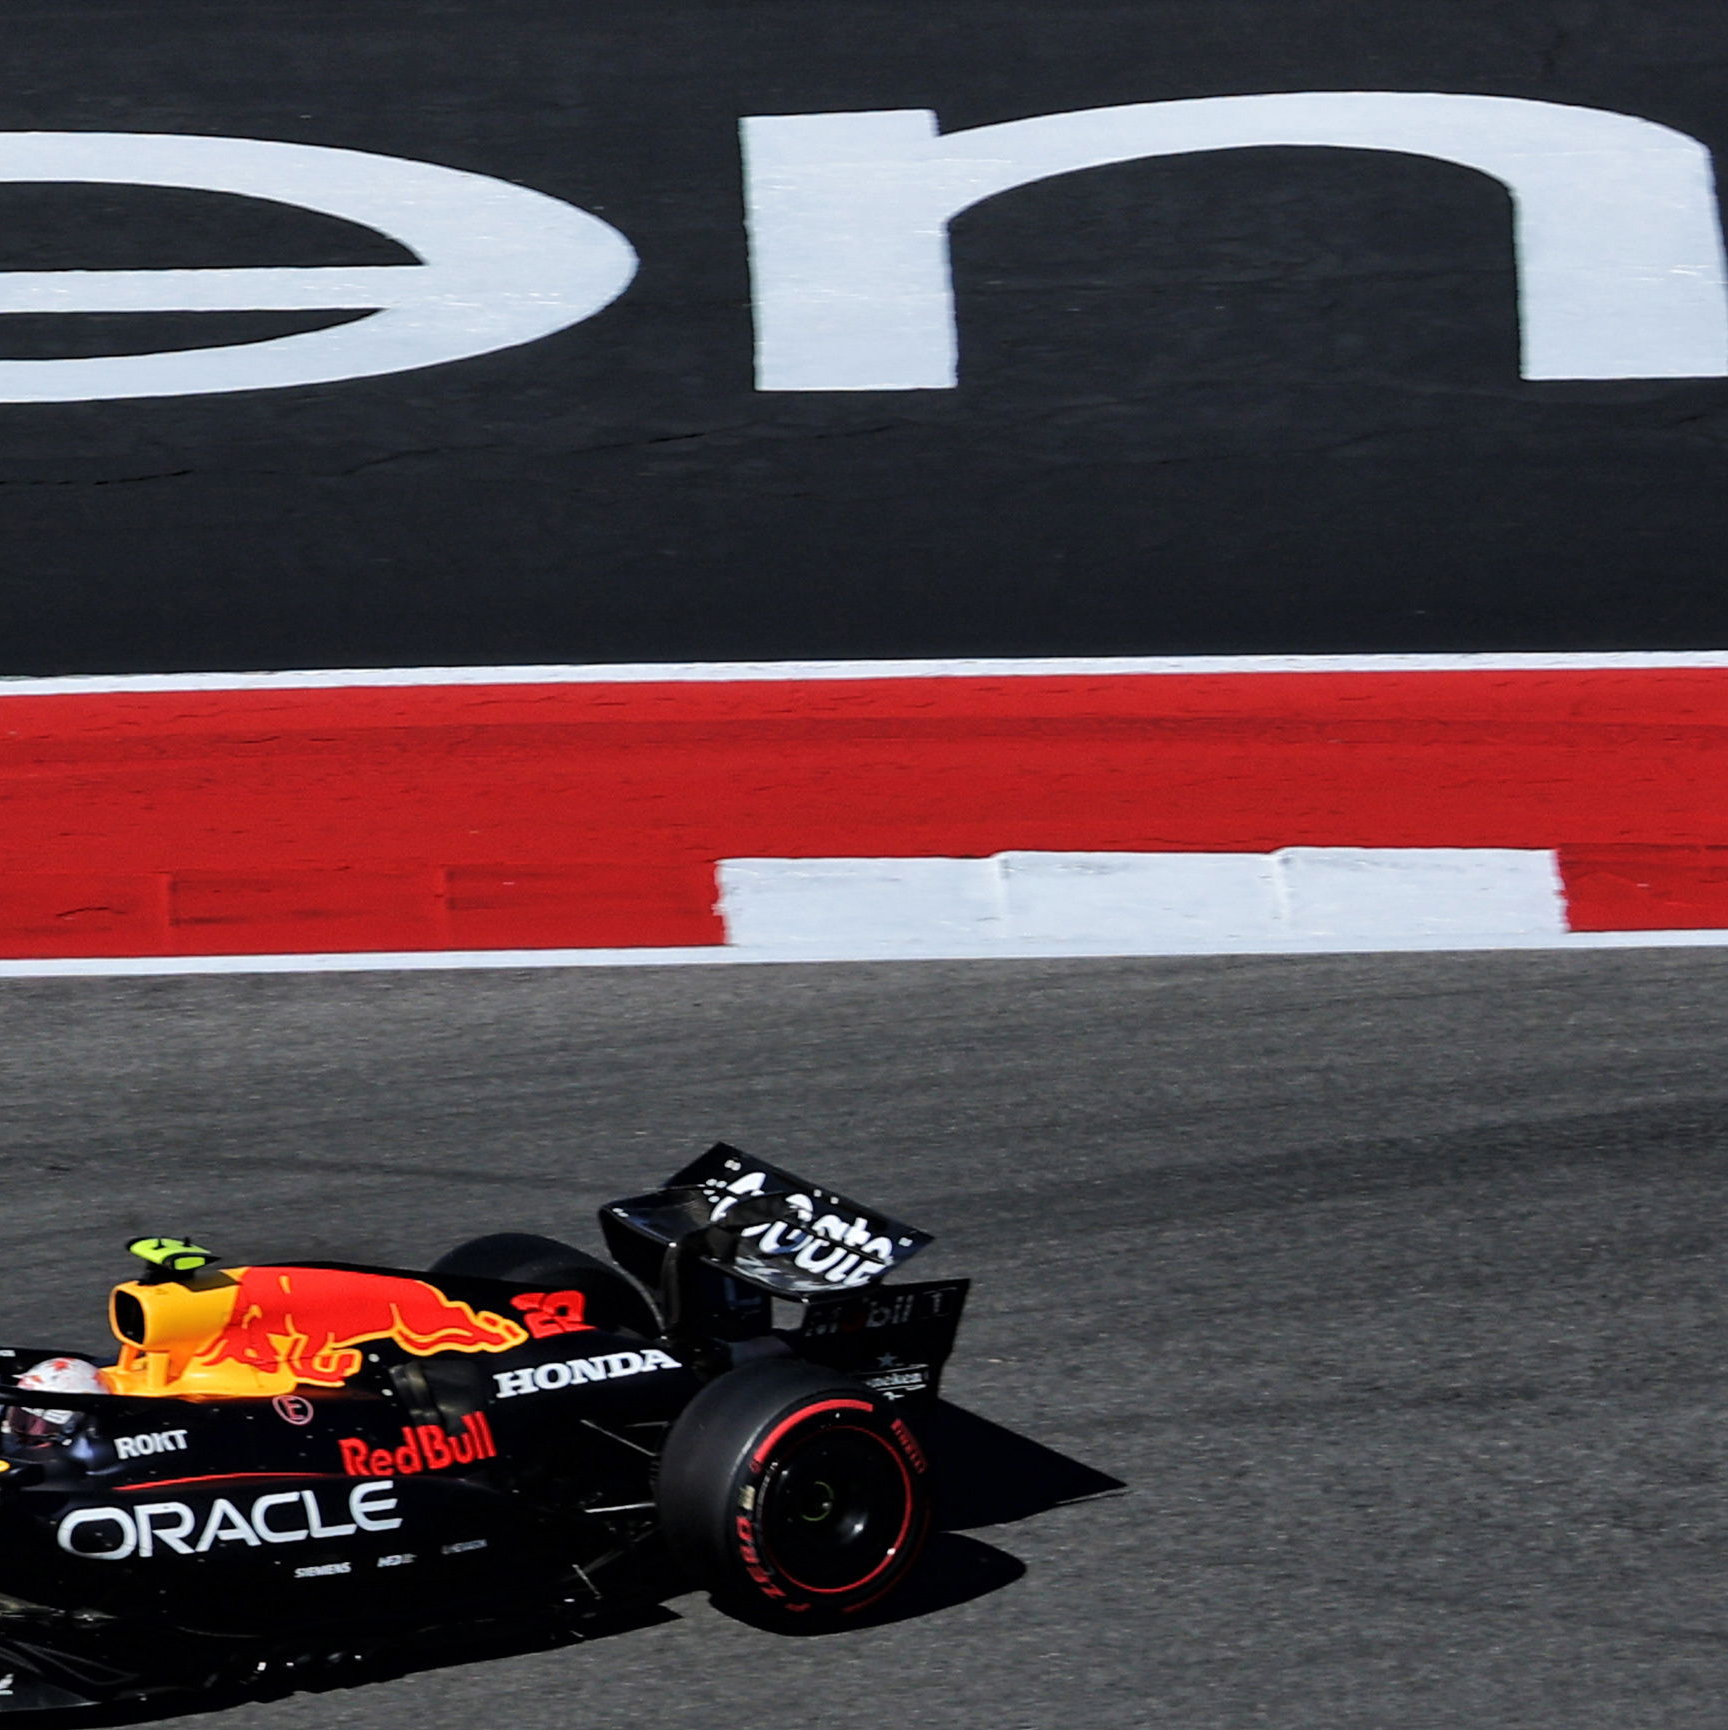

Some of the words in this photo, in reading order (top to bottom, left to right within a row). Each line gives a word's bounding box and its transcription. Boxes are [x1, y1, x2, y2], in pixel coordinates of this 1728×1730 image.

[511, 1290, 596, 1339] 22
[493, 1348, 682, 1399] HONDA
[115, 1430, 188, 1460] ROKT
[58, 1480, 403, 1560] ORACLE
